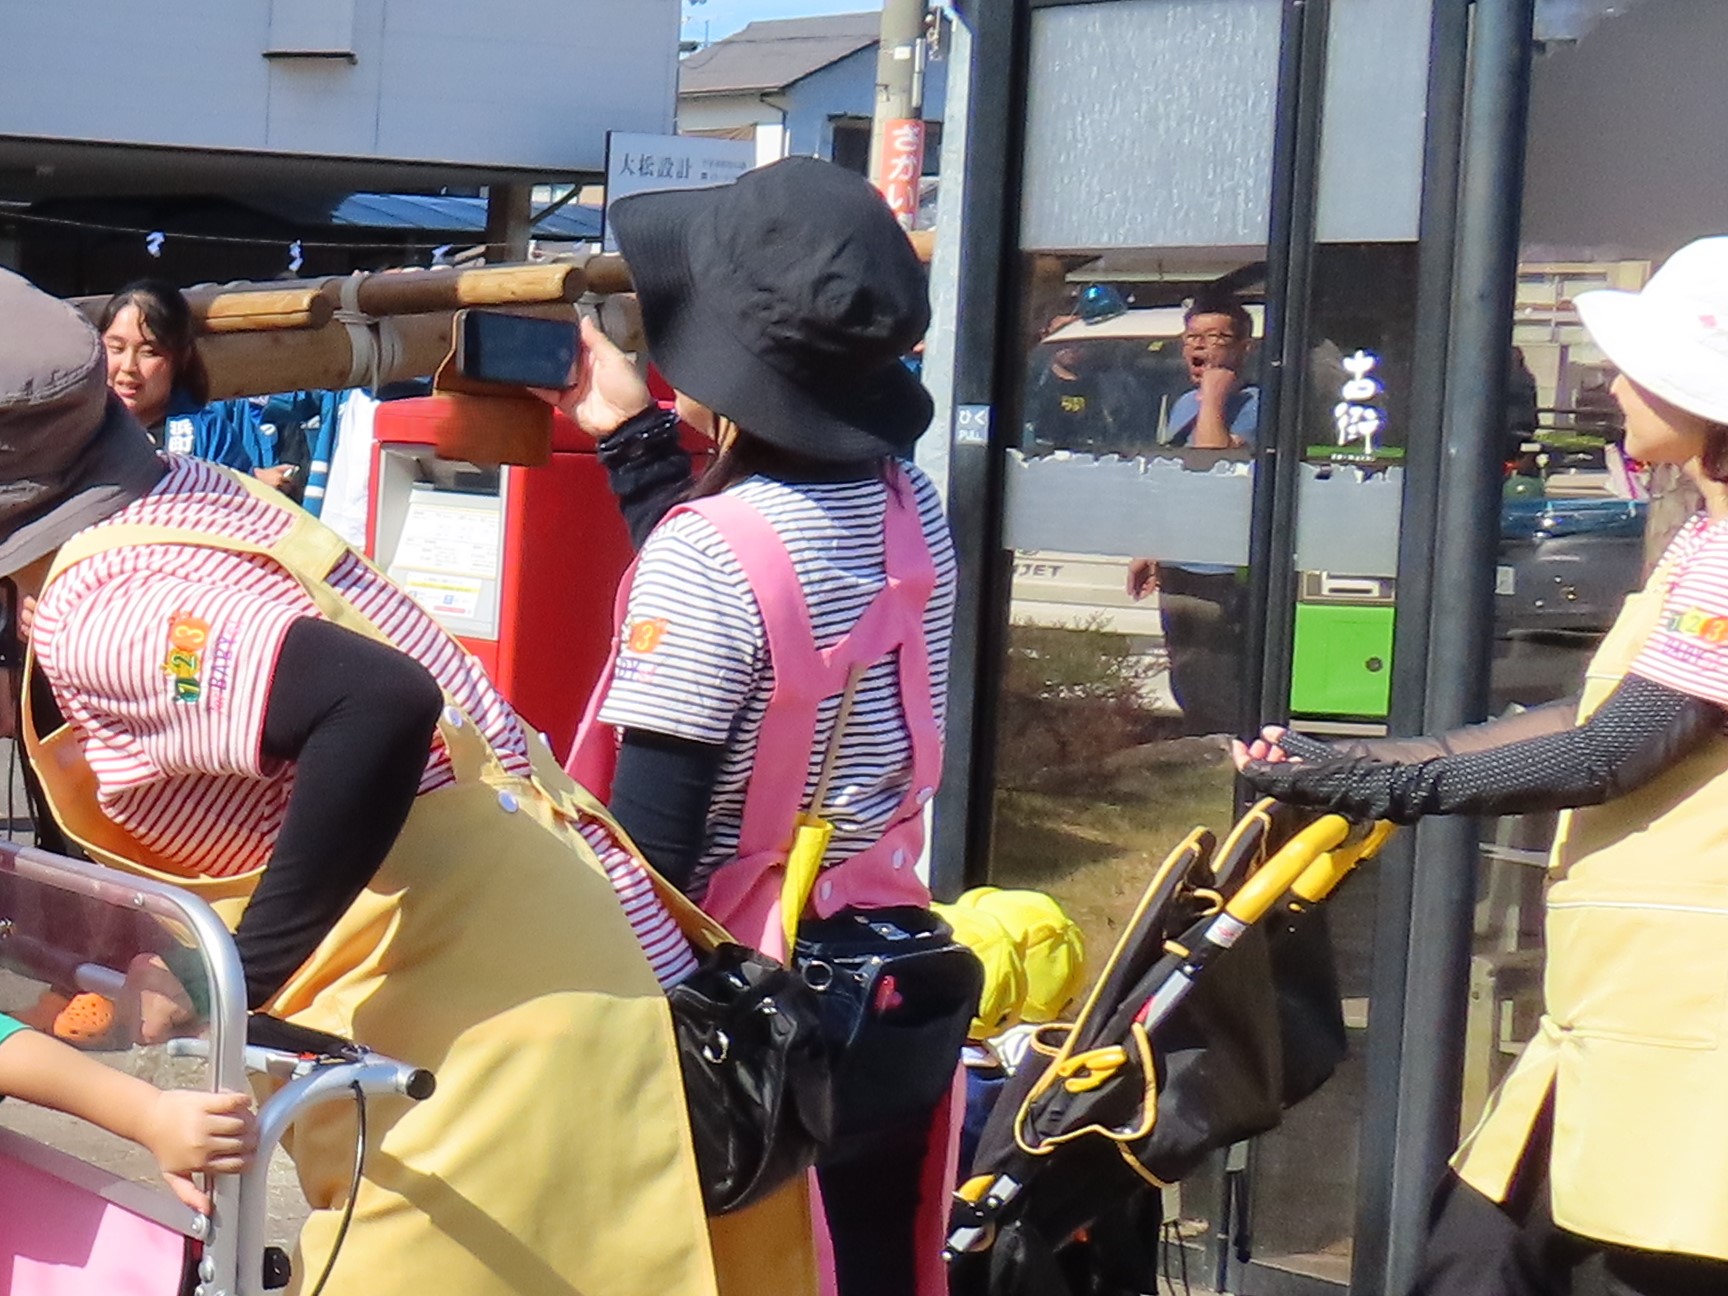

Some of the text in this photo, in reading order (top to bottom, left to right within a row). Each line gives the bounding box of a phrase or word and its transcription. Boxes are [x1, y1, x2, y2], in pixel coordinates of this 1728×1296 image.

[619, 152, 692, 179] 大松設計
[958, 408, 987, 426] ひく
